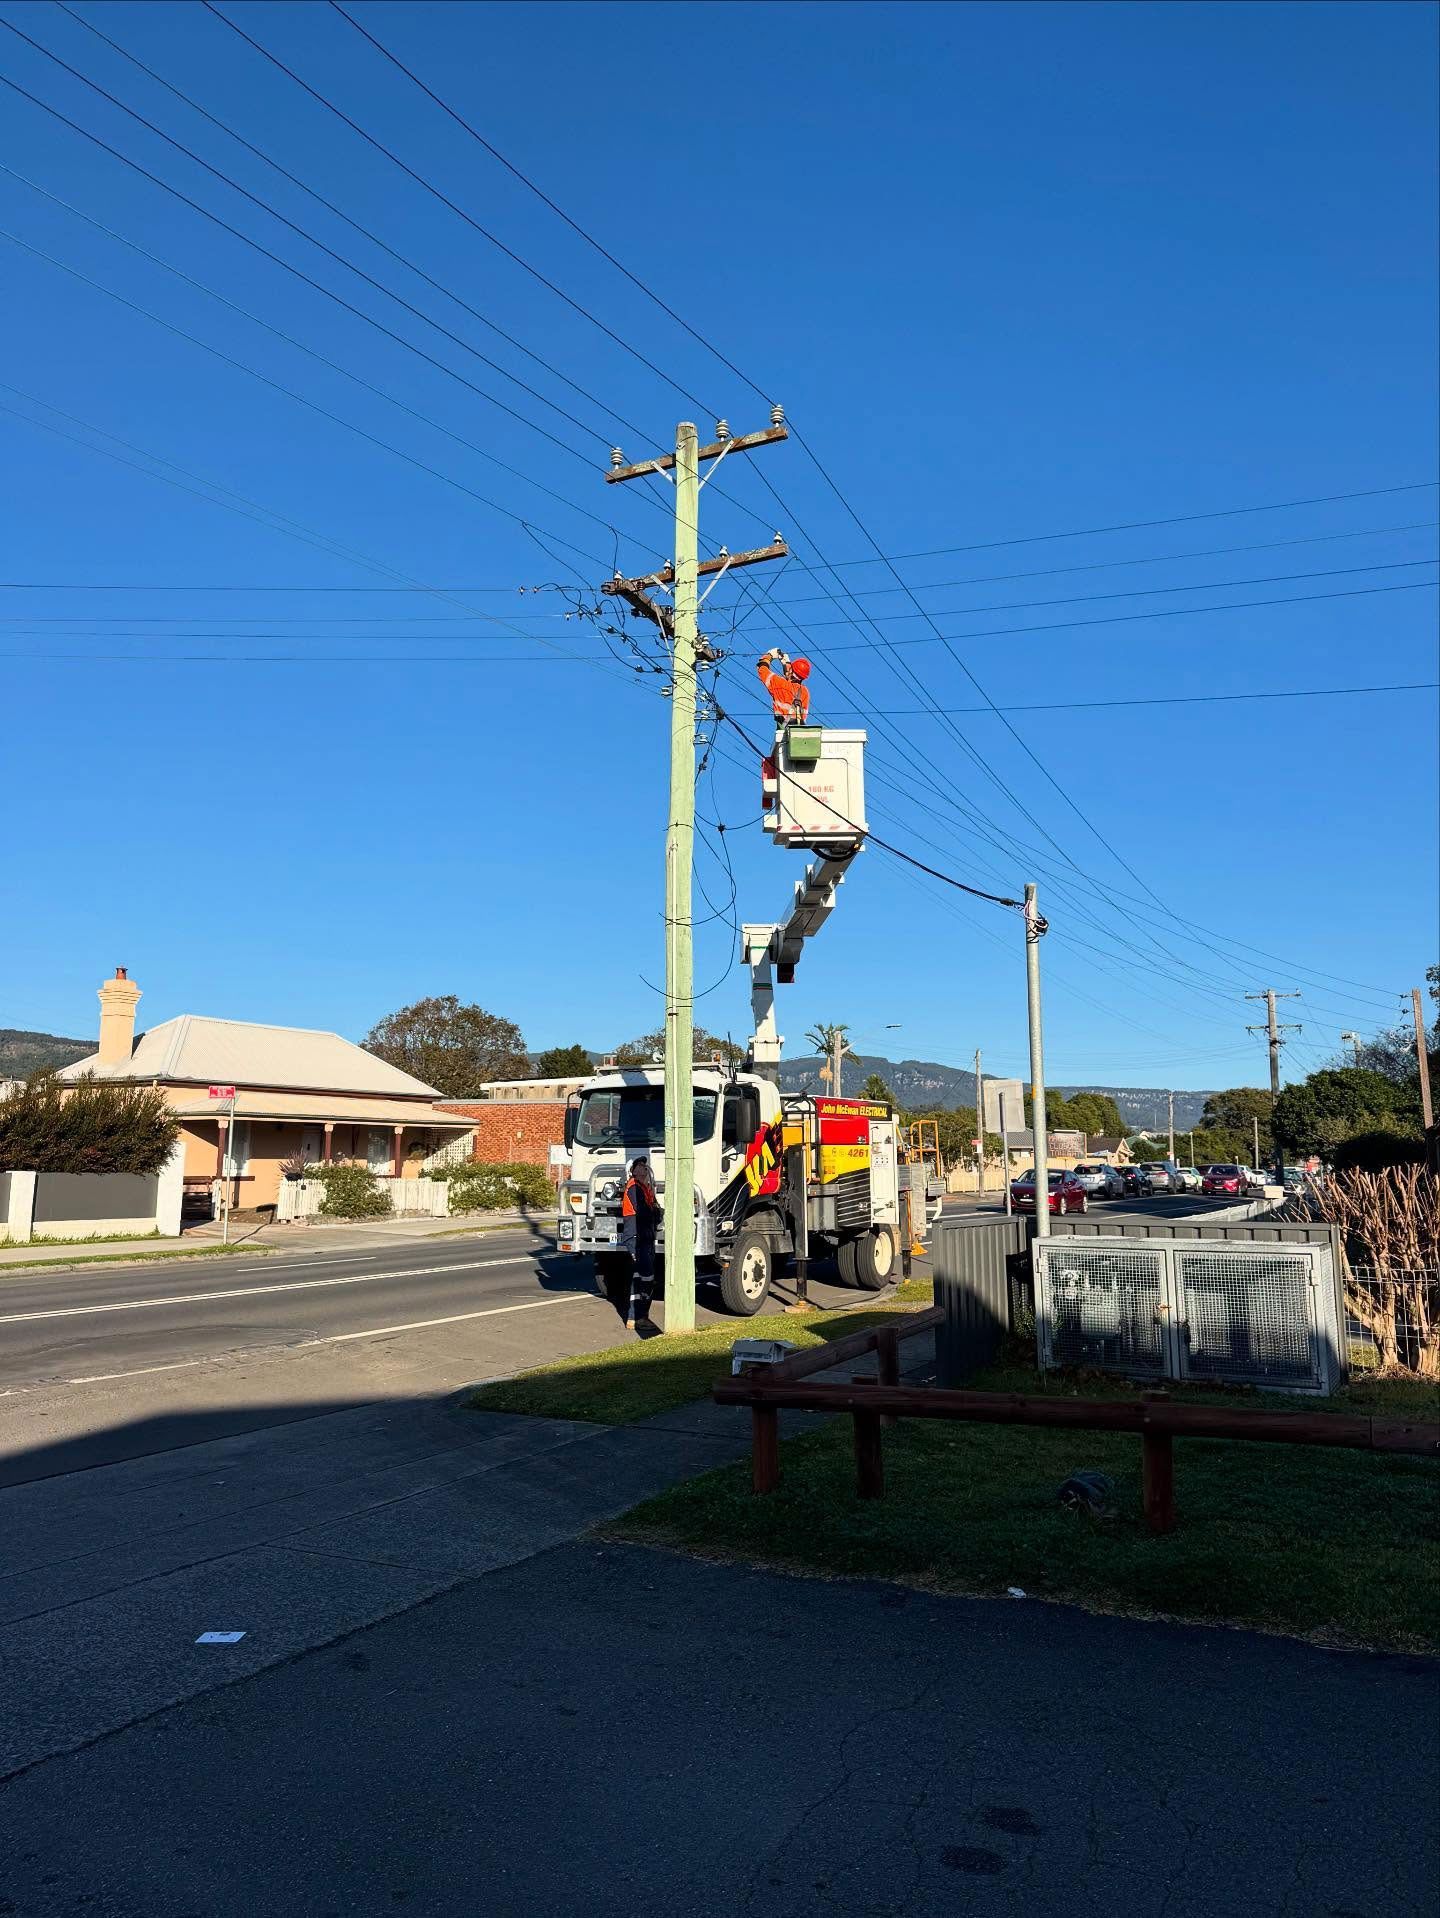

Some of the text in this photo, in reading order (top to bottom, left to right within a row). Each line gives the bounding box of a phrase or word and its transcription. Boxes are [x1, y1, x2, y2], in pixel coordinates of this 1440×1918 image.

[821, 1103, 888, 1118] John McEwan ELECTRICAL
[848, 1149, 869, 1158] 4261
